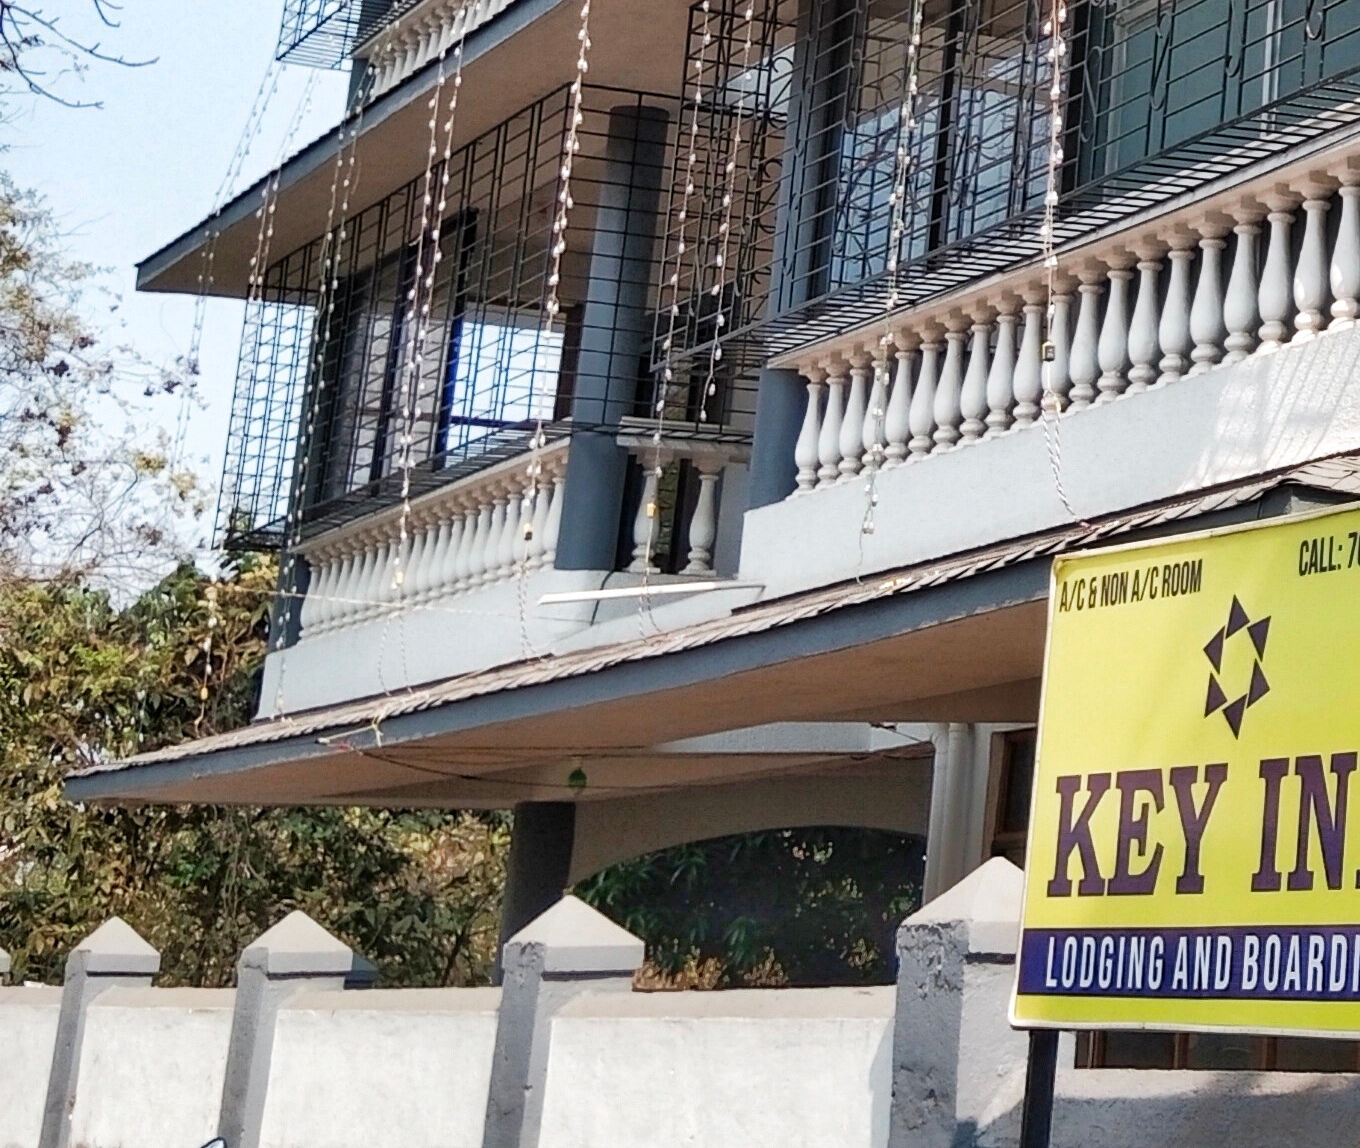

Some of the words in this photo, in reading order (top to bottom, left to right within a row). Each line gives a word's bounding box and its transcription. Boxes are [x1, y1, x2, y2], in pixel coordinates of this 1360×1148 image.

[1299, 536, 1342, 576] CALL:
[1059, 578, 1086, 612] A/C
[1088, 577, 1097, 609] &
[1100, 571, 1129, 607] NON
[1131, 566, 1159, 602] A/C
[1161, 558, 1203, 598] ROOM
[1047, 763, 1228, 897] KEY
[1046, 935, 1164, 990] LODGING
[1172, 935, 1231, 991] AND
